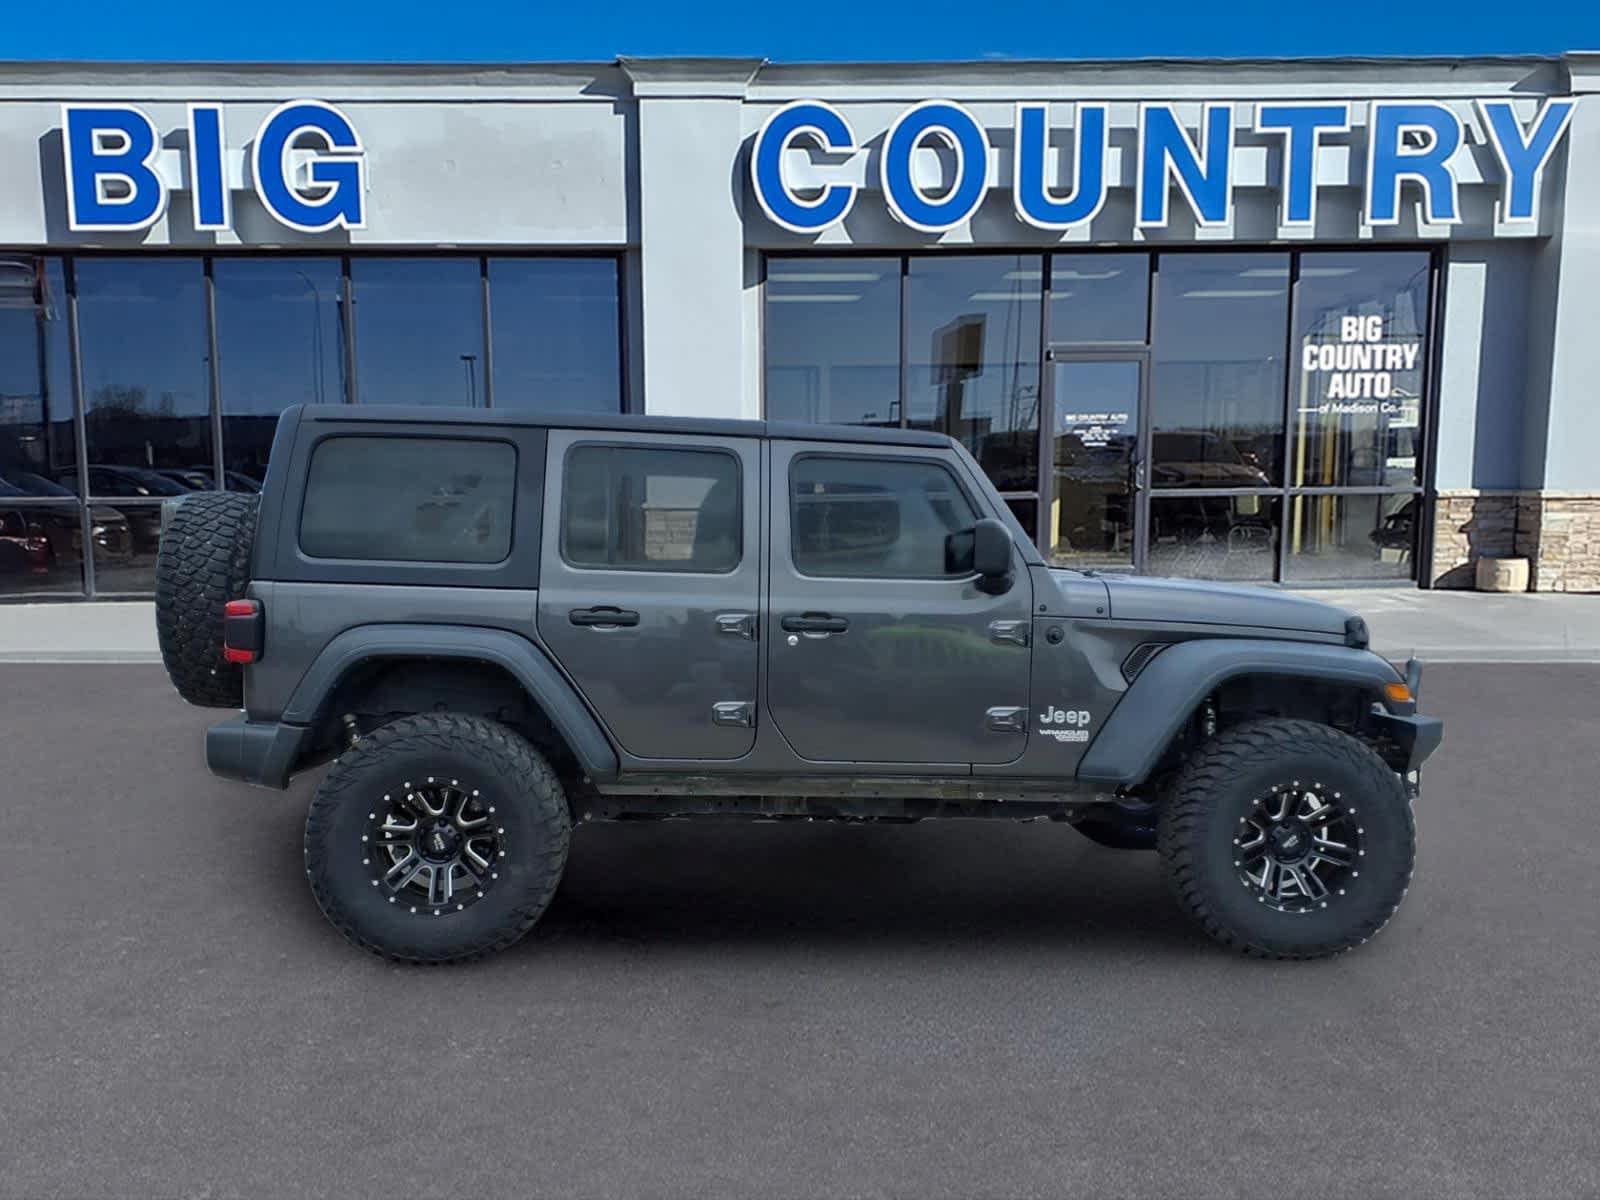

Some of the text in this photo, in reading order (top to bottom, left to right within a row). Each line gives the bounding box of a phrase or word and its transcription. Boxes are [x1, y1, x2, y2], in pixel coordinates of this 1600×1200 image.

[61, 99, 1575, 234] BIG COUNTRY
[1341, 315, 1383, 343] BIG
[1303, 343, 1419, 371] COUNTRY
[1328, 372, 1392, 399] AUTO
[1319, 404, 1331, 414] of
[1331, 403, 1378, 414] Madison
[1040, 706, 1090, 727] Jeep
